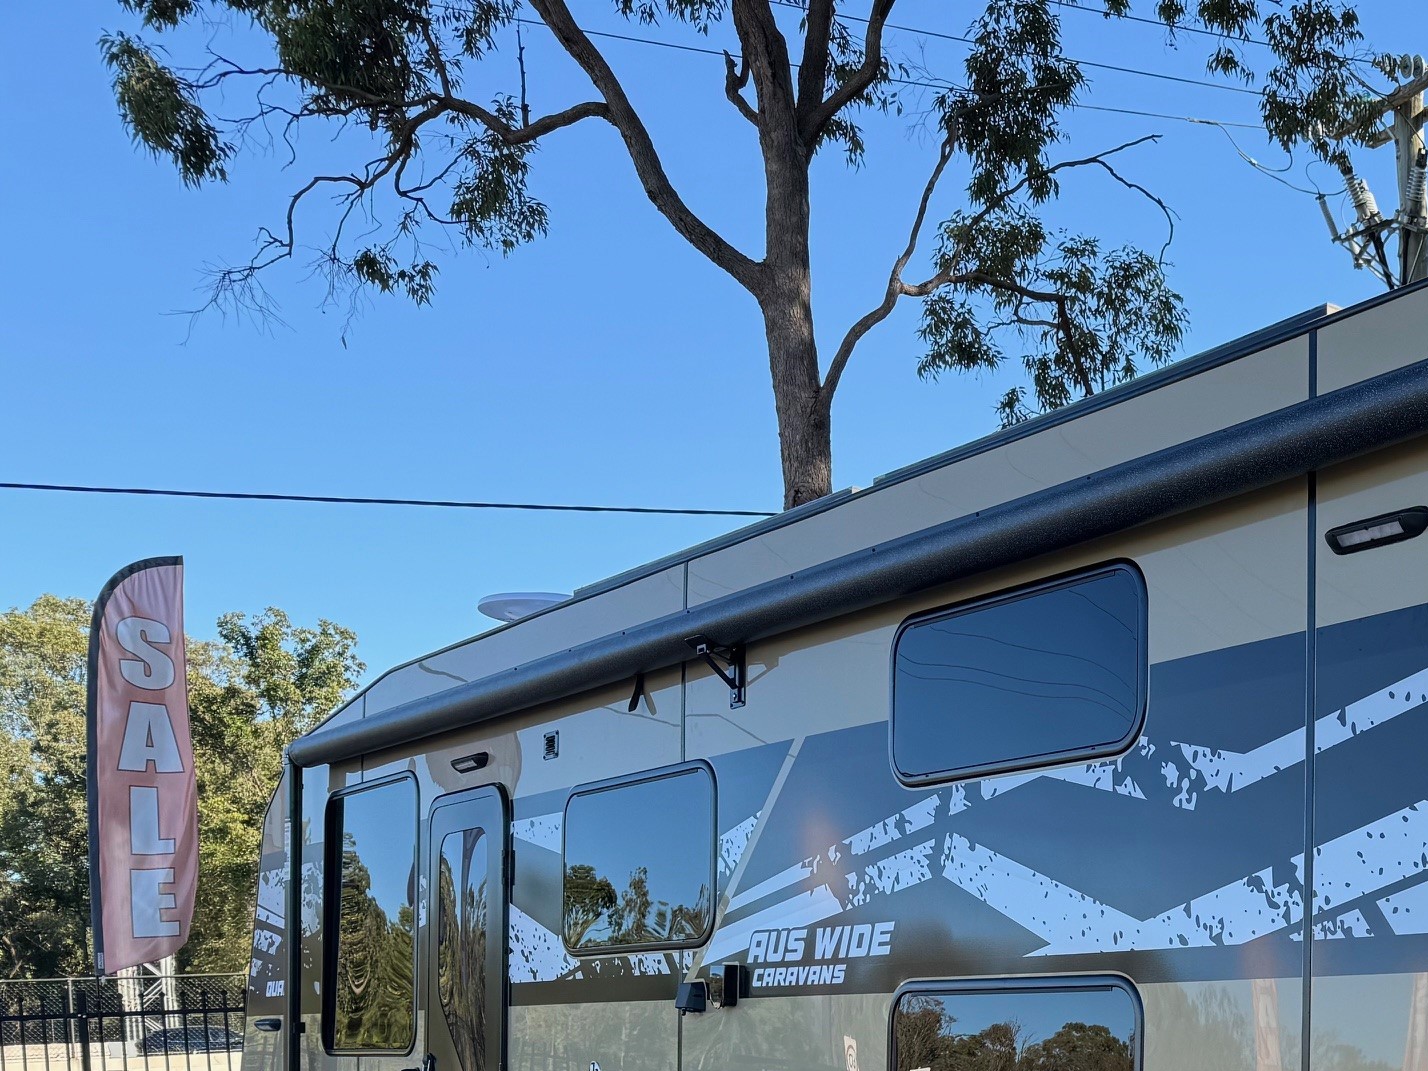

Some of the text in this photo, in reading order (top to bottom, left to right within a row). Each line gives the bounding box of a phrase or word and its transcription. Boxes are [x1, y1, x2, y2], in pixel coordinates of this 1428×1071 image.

[116, 616, 185, 939] SALE
[747, 921, 895, 963] AUS WIDE
[266, 980, 285, 997] QUA
[752, 964, 846, 987] CARAVANS
